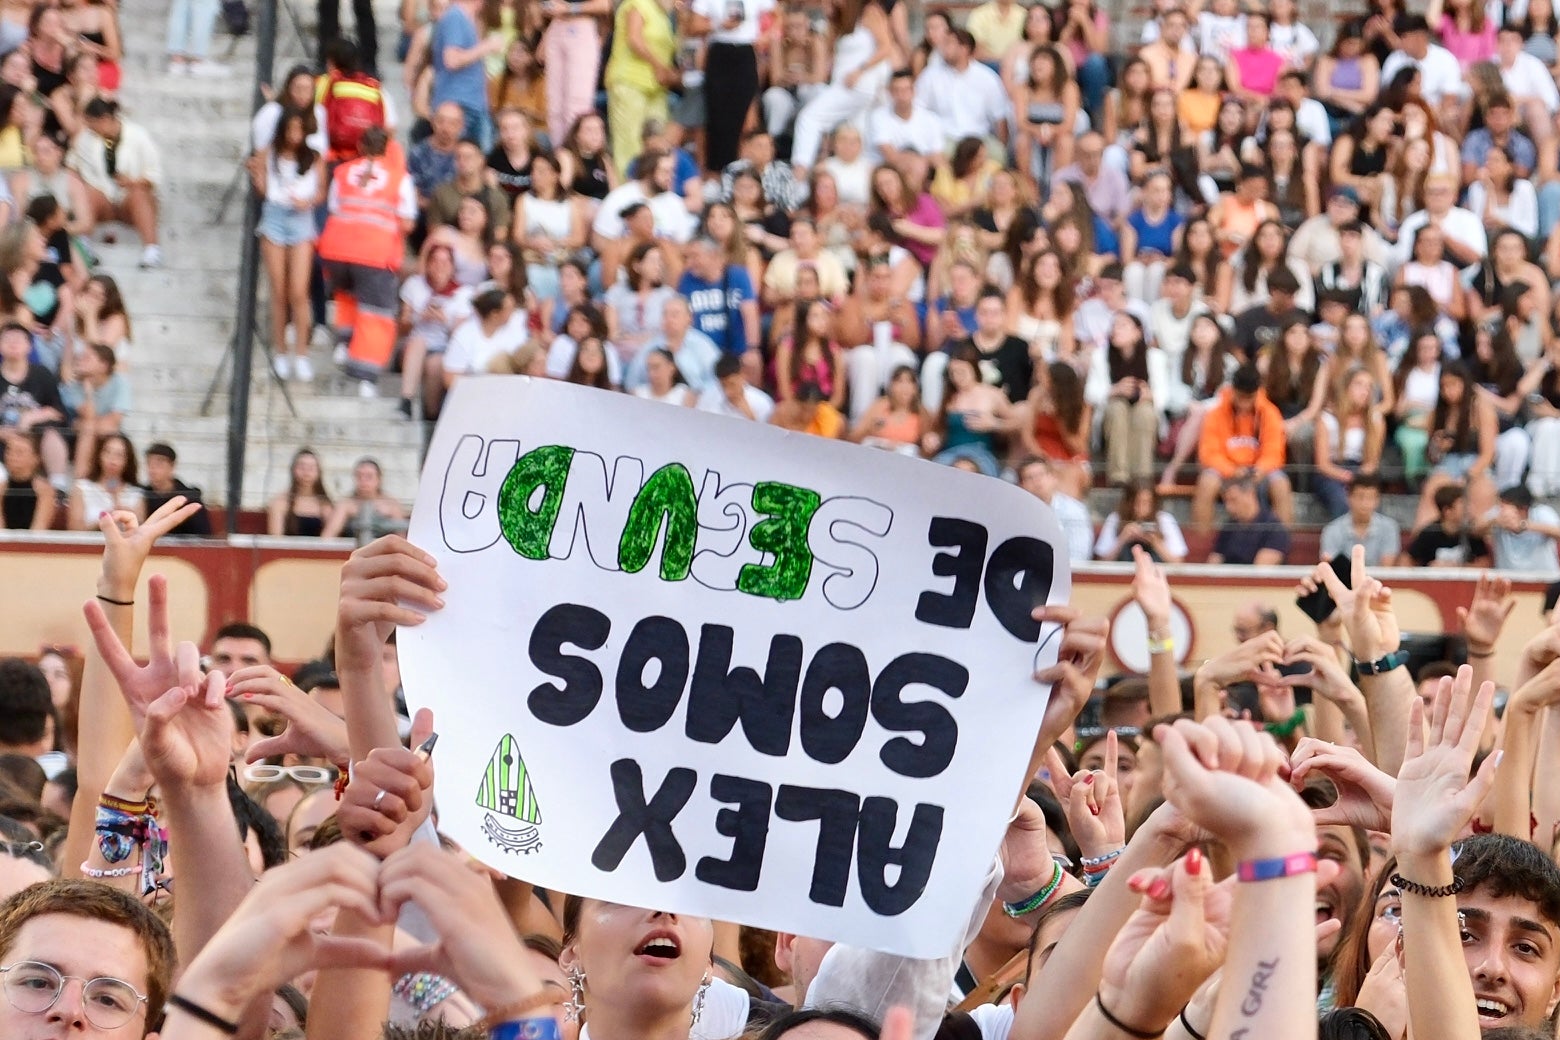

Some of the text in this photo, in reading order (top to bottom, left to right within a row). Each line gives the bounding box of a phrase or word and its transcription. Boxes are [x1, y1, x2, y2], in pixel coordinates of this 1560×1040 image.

[439, 434, 1054, 642] DE SEGUNDA
[527, 603, 969, 778] SOMOS
[591, 758, 944, 916] ALEX
[1241, 956, 1280, 1018] GIRL
